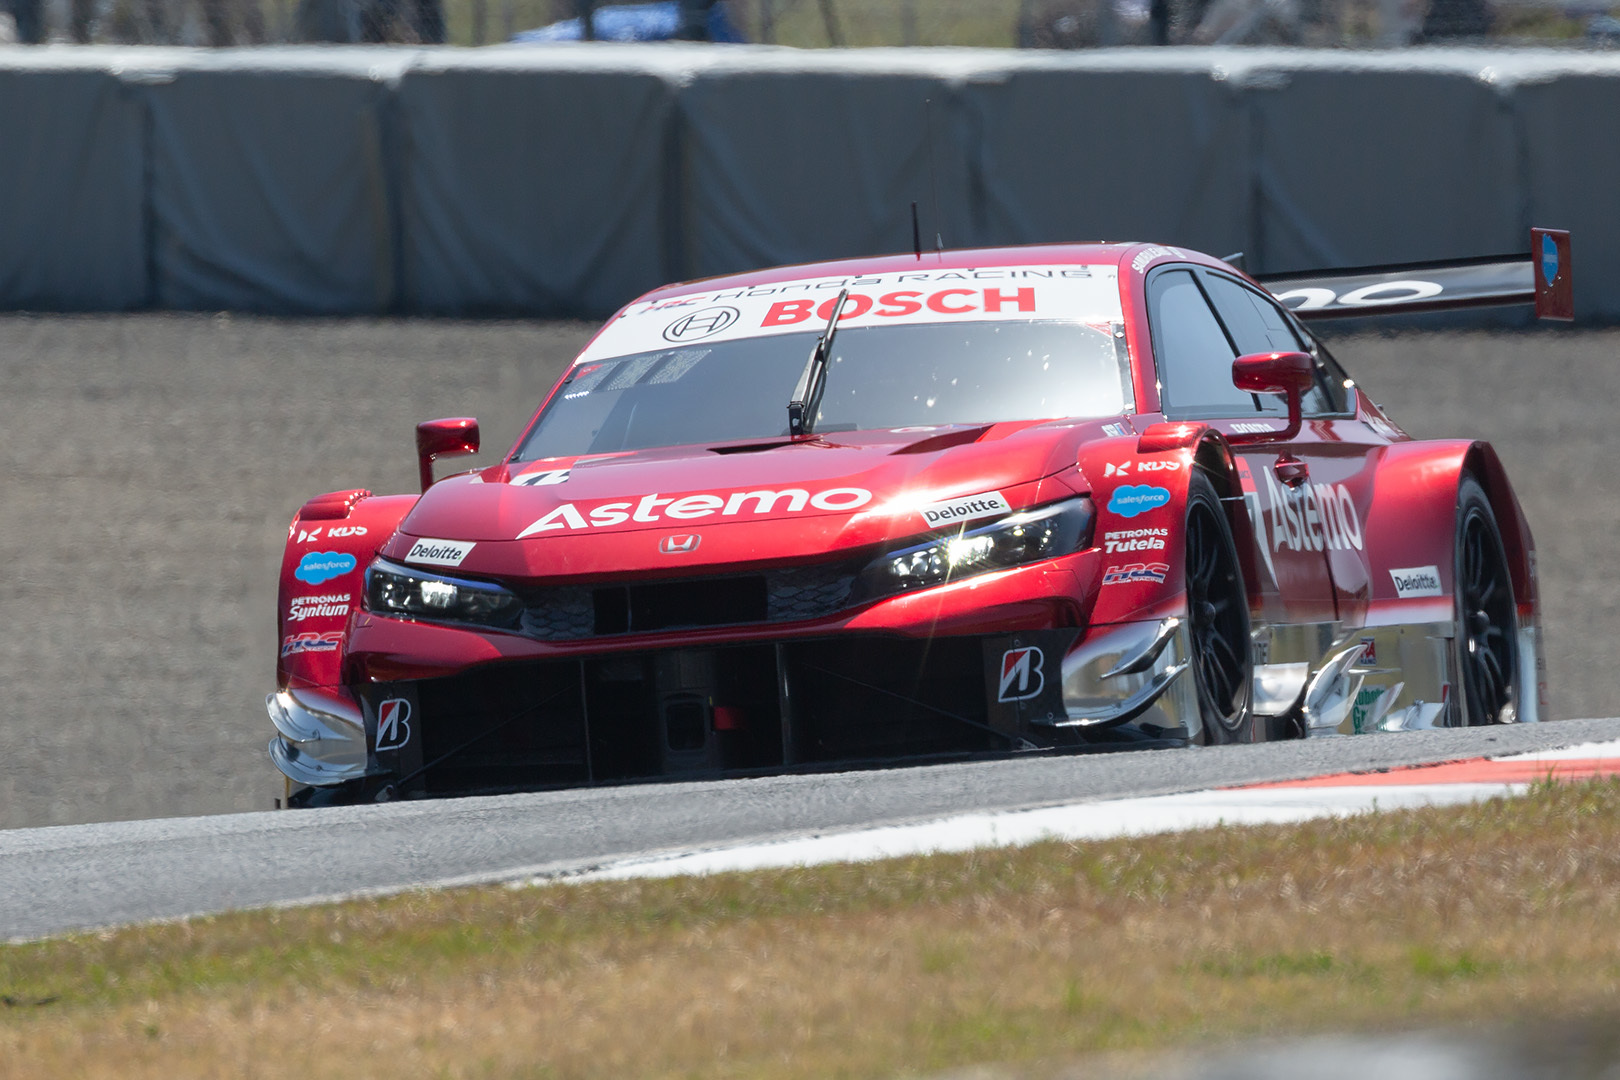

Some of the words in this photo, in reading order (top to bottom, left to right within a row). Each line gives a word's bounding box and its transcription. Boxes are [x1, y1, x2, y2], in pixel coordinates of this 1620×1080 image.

[897, 269, 1093, 283] RACING
[760, 286, 1036, 328] BOSCH
[1116, 494, 1165, 505] salesforce
[515, 487, 873, 541] Astemo
[1263, 465, 1363, 553] Astemo
[1104, 528, 1169, 541] PETRONAS
[1104, 537, 1166, 554] Tutela
[303, 561, 351, 571] salesforce
[291, 593, 351, 607] PETRONAS
[287, 603, 350, 622] Syntium
